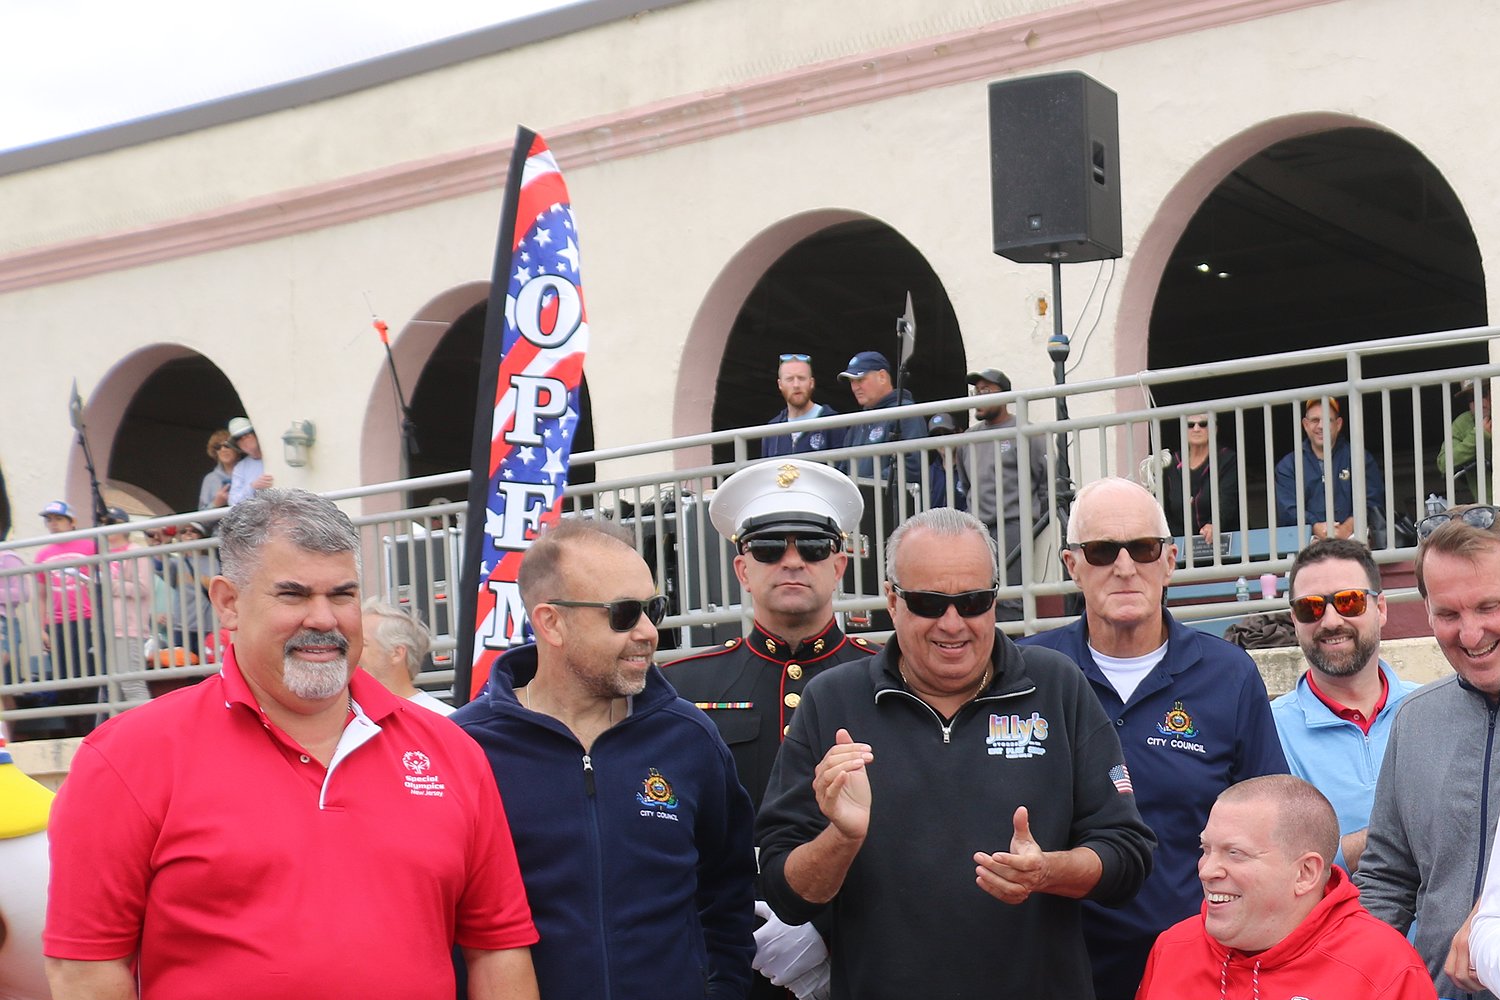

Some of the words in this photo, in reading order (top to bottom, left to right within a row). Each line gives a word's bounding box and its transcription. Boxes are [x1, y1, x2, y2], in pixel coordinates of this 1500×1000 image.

[1147, 737, 1167, 746] CITY
[1170, 739, 1207, 753] COUNCIL
[404, 781, 445, 790] Olympics
